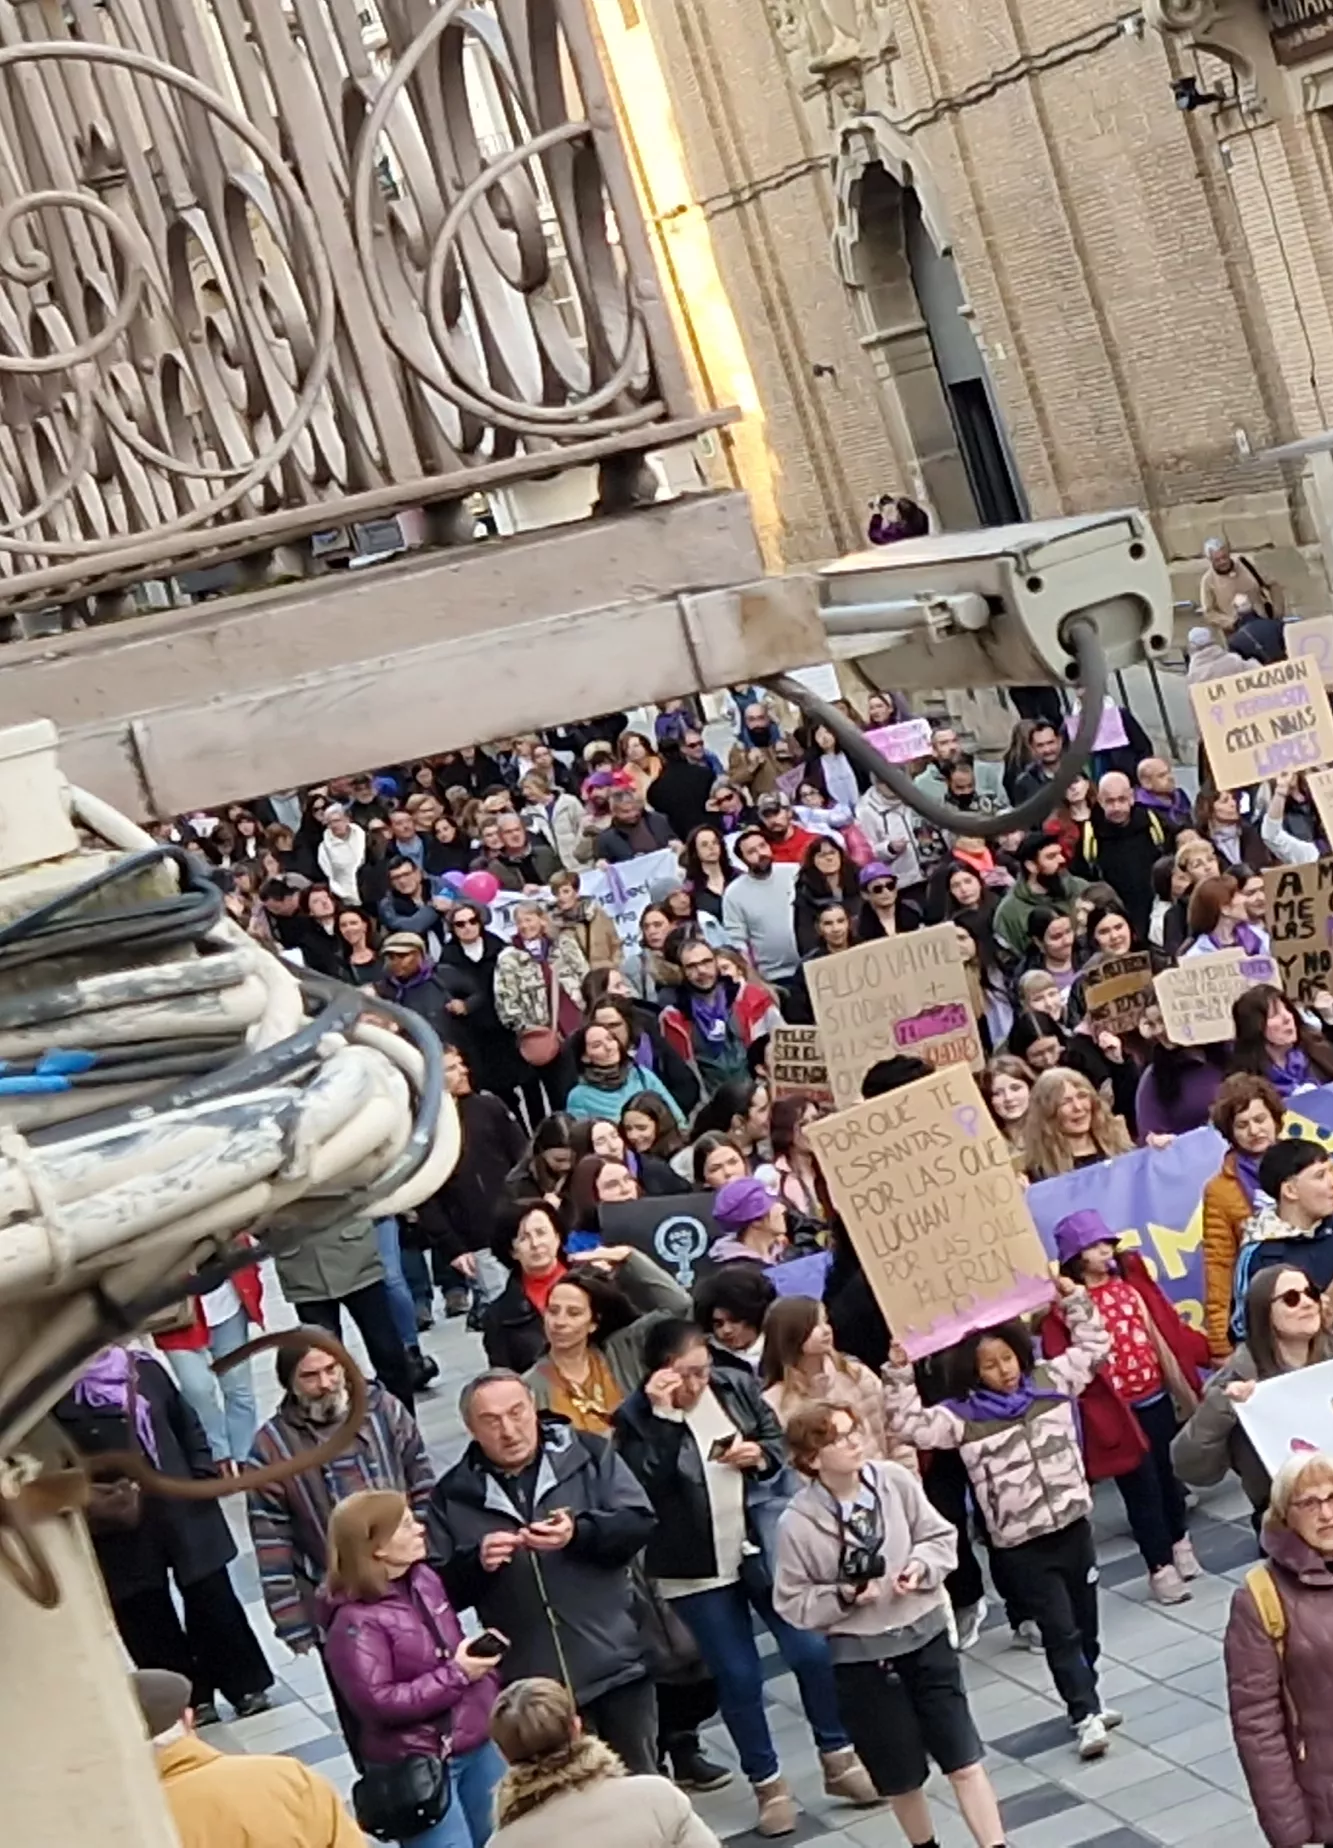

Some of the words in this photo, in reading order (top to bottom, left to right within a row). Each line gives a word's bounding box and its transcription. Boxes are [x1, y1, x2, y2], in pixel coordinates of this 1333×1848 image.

[1277, 872, 1302, 900] A
[1274, 898, 1316, 926] ME
[1271, 918, 1316, 942] LAS
[1304, 949, 1332, 976] NO
[932, 1083, 960, 1109] TE
[834, 1124, 954, 1188] ESPANTAS
[850, 1180, 903, 1220] POR
[907, 1157, 955, 1197] LAS
[960, 1136, 1009, 1173] QUE
[866, 1204, 951, 1258] LUCHAN
[977, 1173, 1014, 1206] NO
[882, 1257, 925, 1286] POR
[932, 1234, 974, 1265] LAS
[977, 1208, 1031, 1246] QUE
